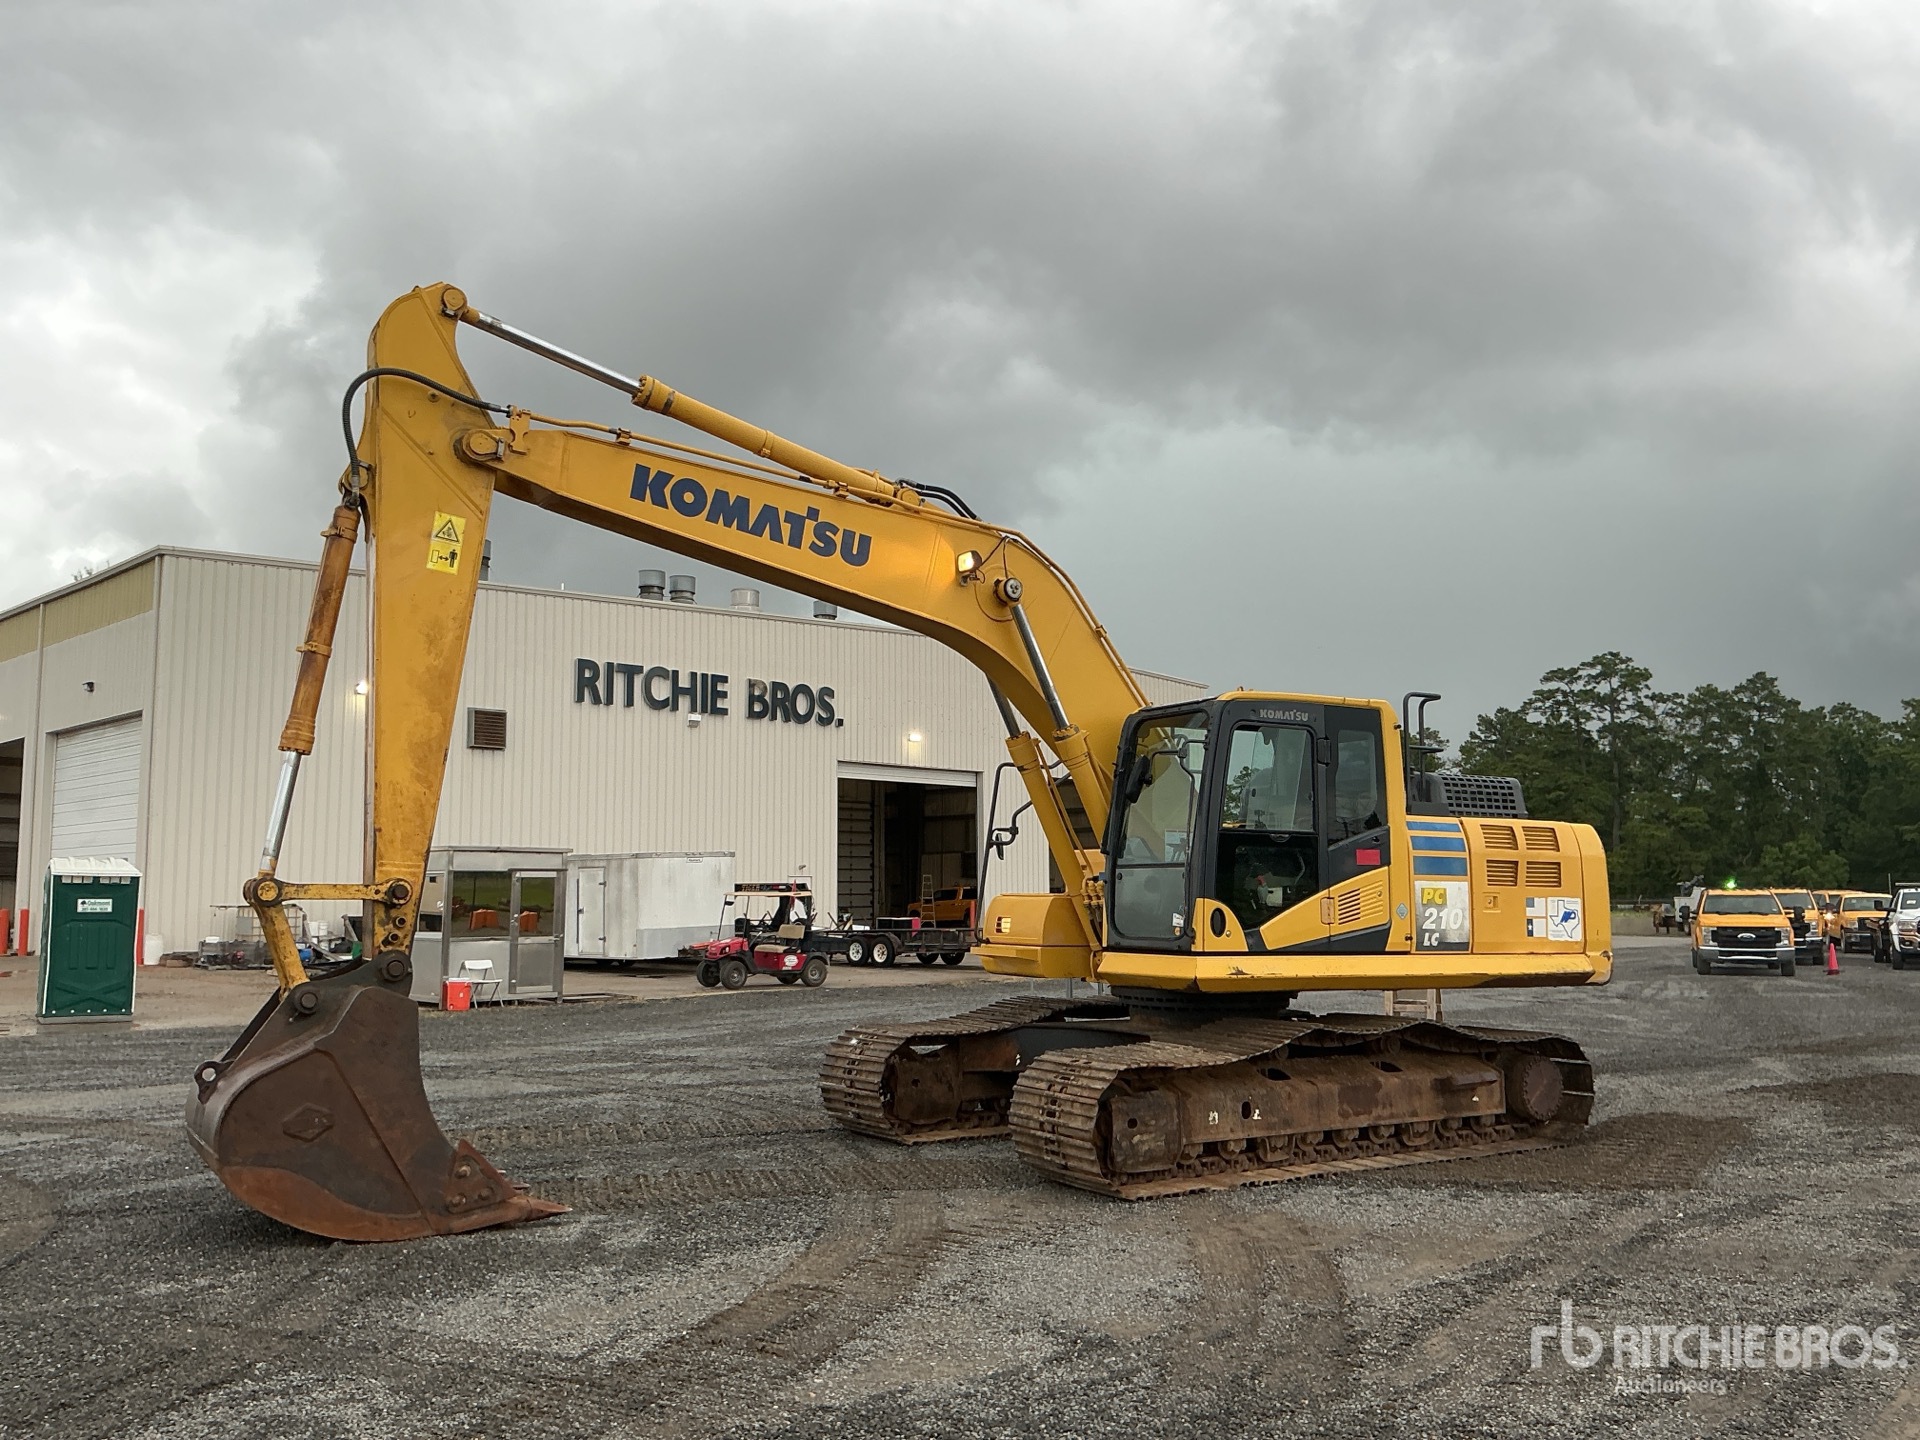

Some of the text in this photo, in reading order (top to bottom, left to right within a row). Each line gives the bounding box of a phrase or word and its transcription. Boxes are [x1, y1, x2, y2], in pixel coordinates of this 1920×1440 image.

[629, 463, 873, 567] KOMATSU
[575, 658, 844, 728] RITCHIE BROS.
[1259, 708, 1309, 722] KOMATSU
[1422, 888, 1445, 905] PC
[1422, 907, 1463, 930] 210
[1422, 932, 1440, 947] LC
